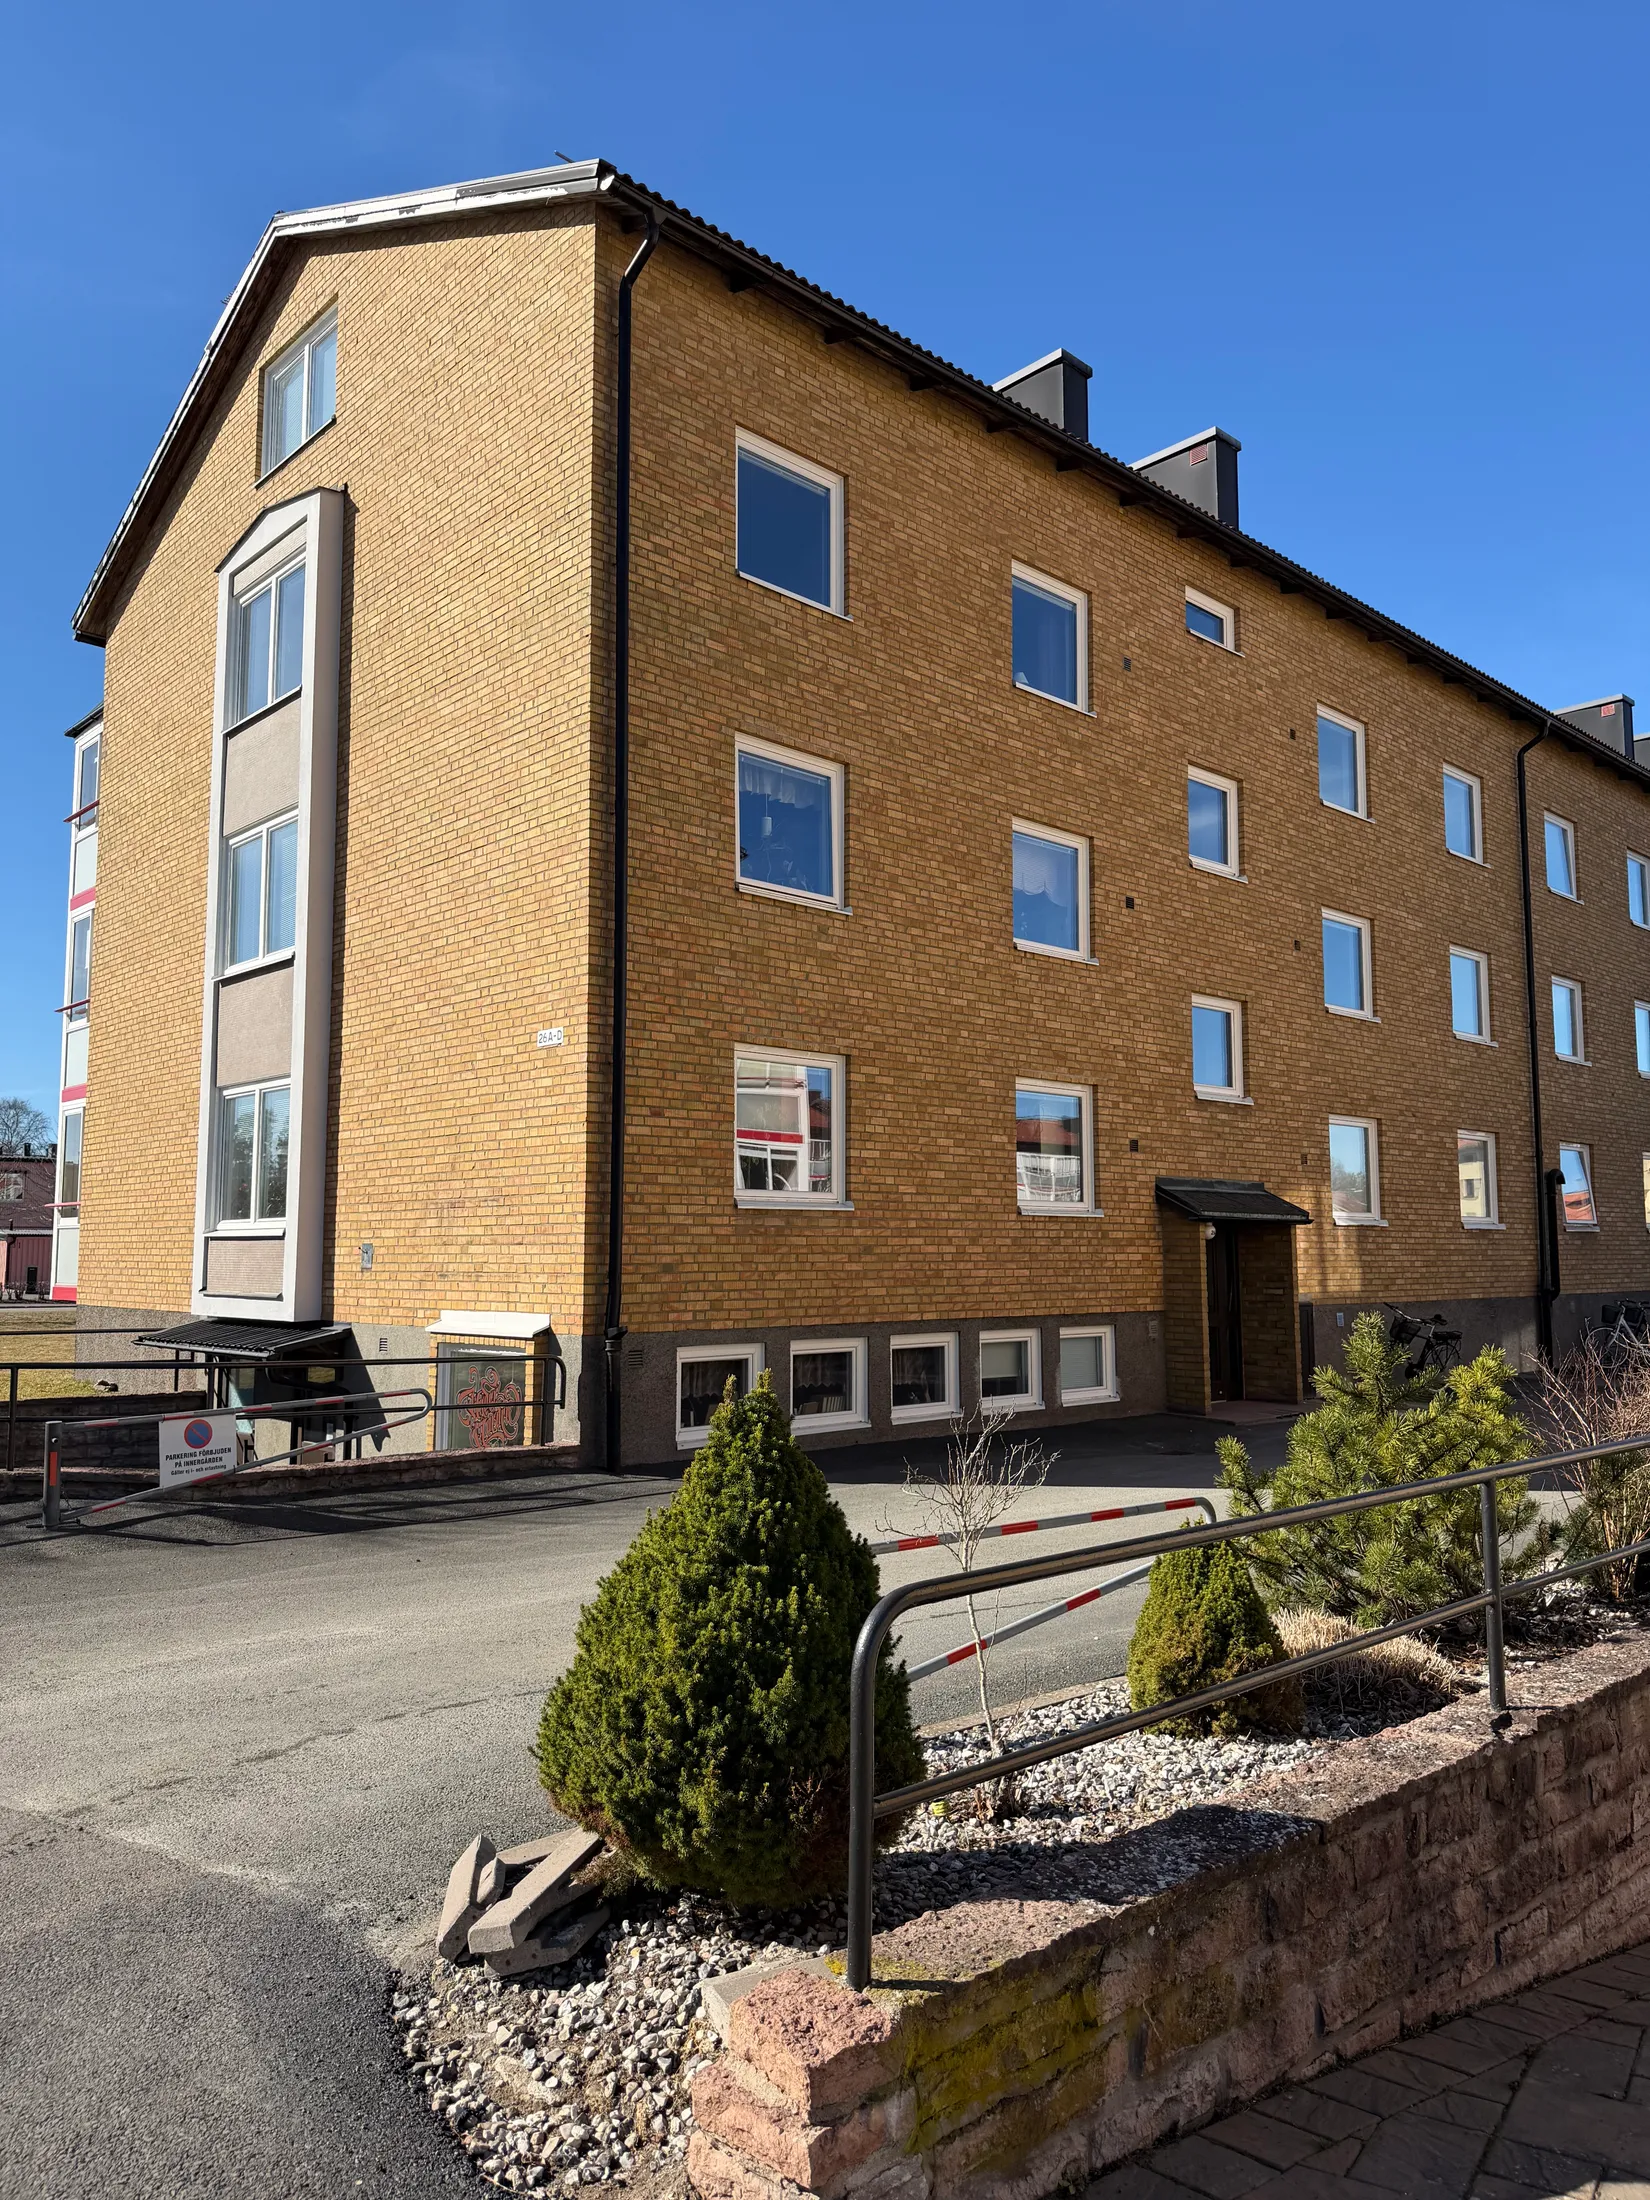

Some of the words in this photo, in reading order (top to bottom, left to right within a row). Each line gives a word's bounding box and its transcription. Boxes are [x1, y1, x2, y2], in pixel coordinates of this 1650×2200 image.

[166, 1452, 197, 1461] PARKERING
[199, 1447, 231, 1456] FÖRBJUDEN
[184, 1456, 222, 1466] INNERGÅRDEN
